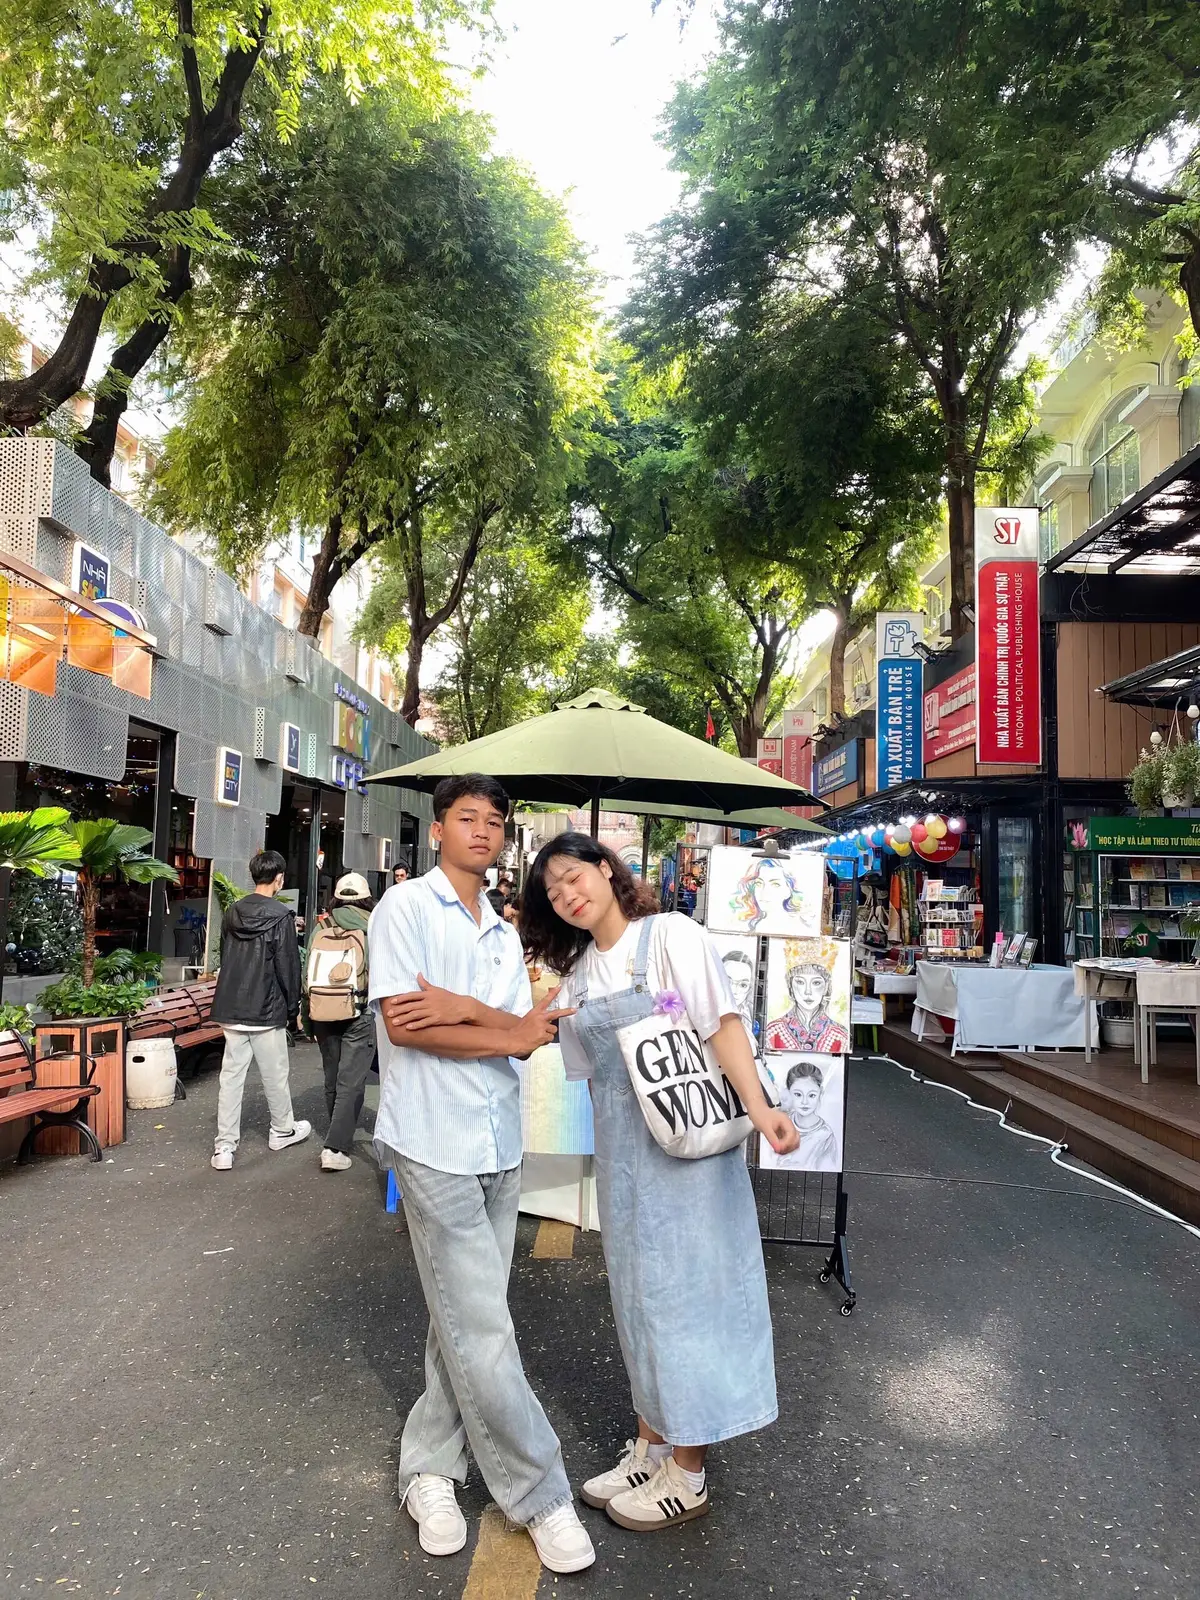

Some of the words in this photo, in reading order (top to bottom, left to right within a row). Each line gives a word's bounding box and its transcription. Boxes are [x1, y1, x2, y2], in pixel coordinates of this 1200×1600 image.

[994, 517, 1021, 545] ST
[82, 560, 106, 585] NHÀ
[994, 571, 1010, 592] THẬT
[995, 592, 1010, 605] SỰ
[1014, 572, 1023, 602] HOUSE
[996, 606, 1009, 620] GIA
[993, 622, 1010, 643] QUỐC
[1014, 604, 1024, 656] PUBLISHING
[996, 646, 1010, 660] TRỊ
[883, 667, 903, 693] TRẺ
[905, 666, 913, 699] HOUSE
[995, 661, 1009, 686] CHÍNH
[1015, 659, 1024, 702] POLITICAL
[993, 688, 1009, 706] BẢN
[883, 698, 903, 725] BẢN
[993, 707, 1010, 729] XUẤT
[905, 705, 913, 768] PUBLISHING
[1015, 704, 1024, 748] NATIONAL
[883, 729, 903, 763] XUẤT
[995, 730, 1010, 748] NHÀ
[1113, 834, 1126, 847] TẬP
[1127, 835, 1136, 846] VÀ
[1137, 835, 1152, 847] LÀM
[1153, 837, 1169, 847] THEO
[1170, 837, 1179, 847] TƯ
[1136, 932, 1148, 947] ST
[635, 1029, 709, 1085] GEN
[647, 1073, 750, 1136] WOM
